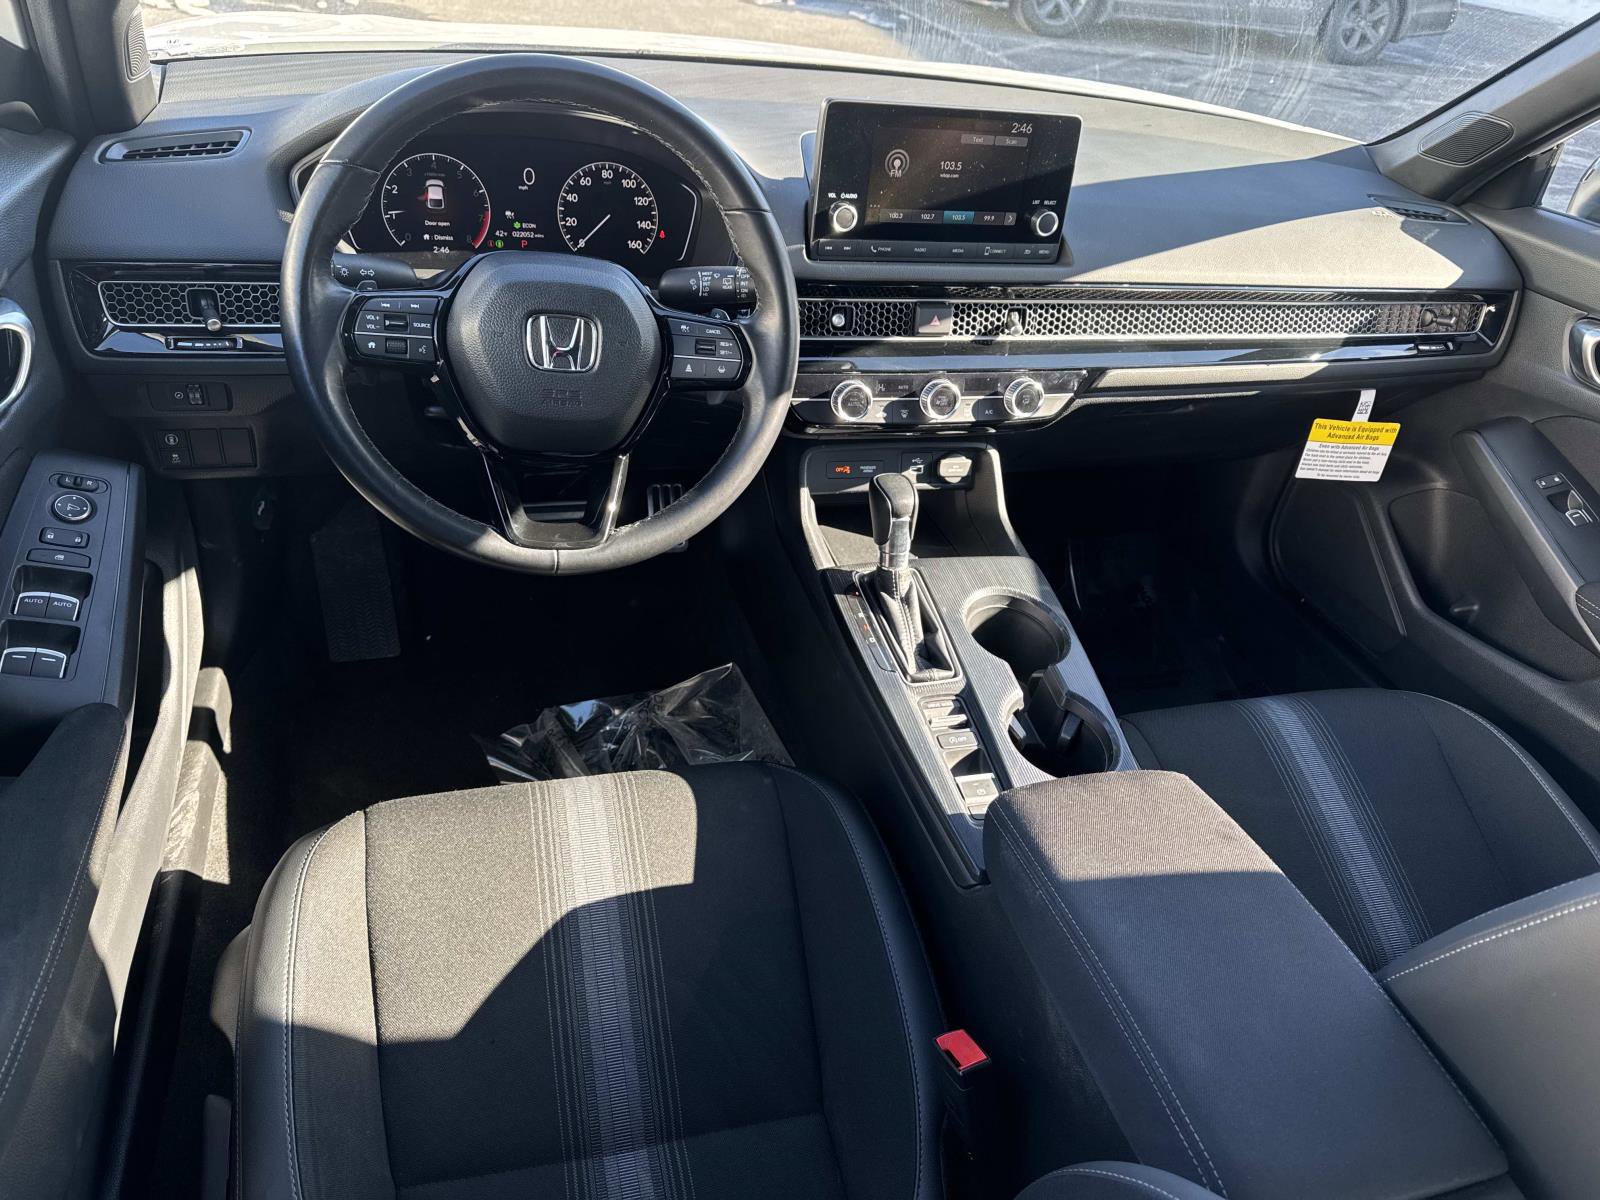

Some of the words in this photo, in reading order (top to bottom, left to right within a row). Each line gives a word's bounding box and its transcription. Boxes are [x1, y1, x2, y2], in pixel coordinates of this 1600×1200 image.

[1011, 122, 1033, 134] 2:46
[940, 161, 962, 171] 103.5
[523, 167, 535, 185] 0
[601, 169, 613, 179] 80
[890, 169, 902, 178] FM
[579, 177, 592, 186] 60
[621, 179, 637, 188] 100
[391, 185, 398, 194] 2
[566, 193, 578, 202] 40
[634, 197, 649, 206] 120
[565, 218, 577, 226] 20
[637, 221, 651, 229] 140
[522, 240, 528, 248] P
[628, 240, 642, 249] 160
[433, 246, 450, 254] 2:46
[1328, 423, 1350, 432] Vehicle
[1357, 425, 1384, 434] Equipped
[1327, 432, 1355, 440] Advanced
